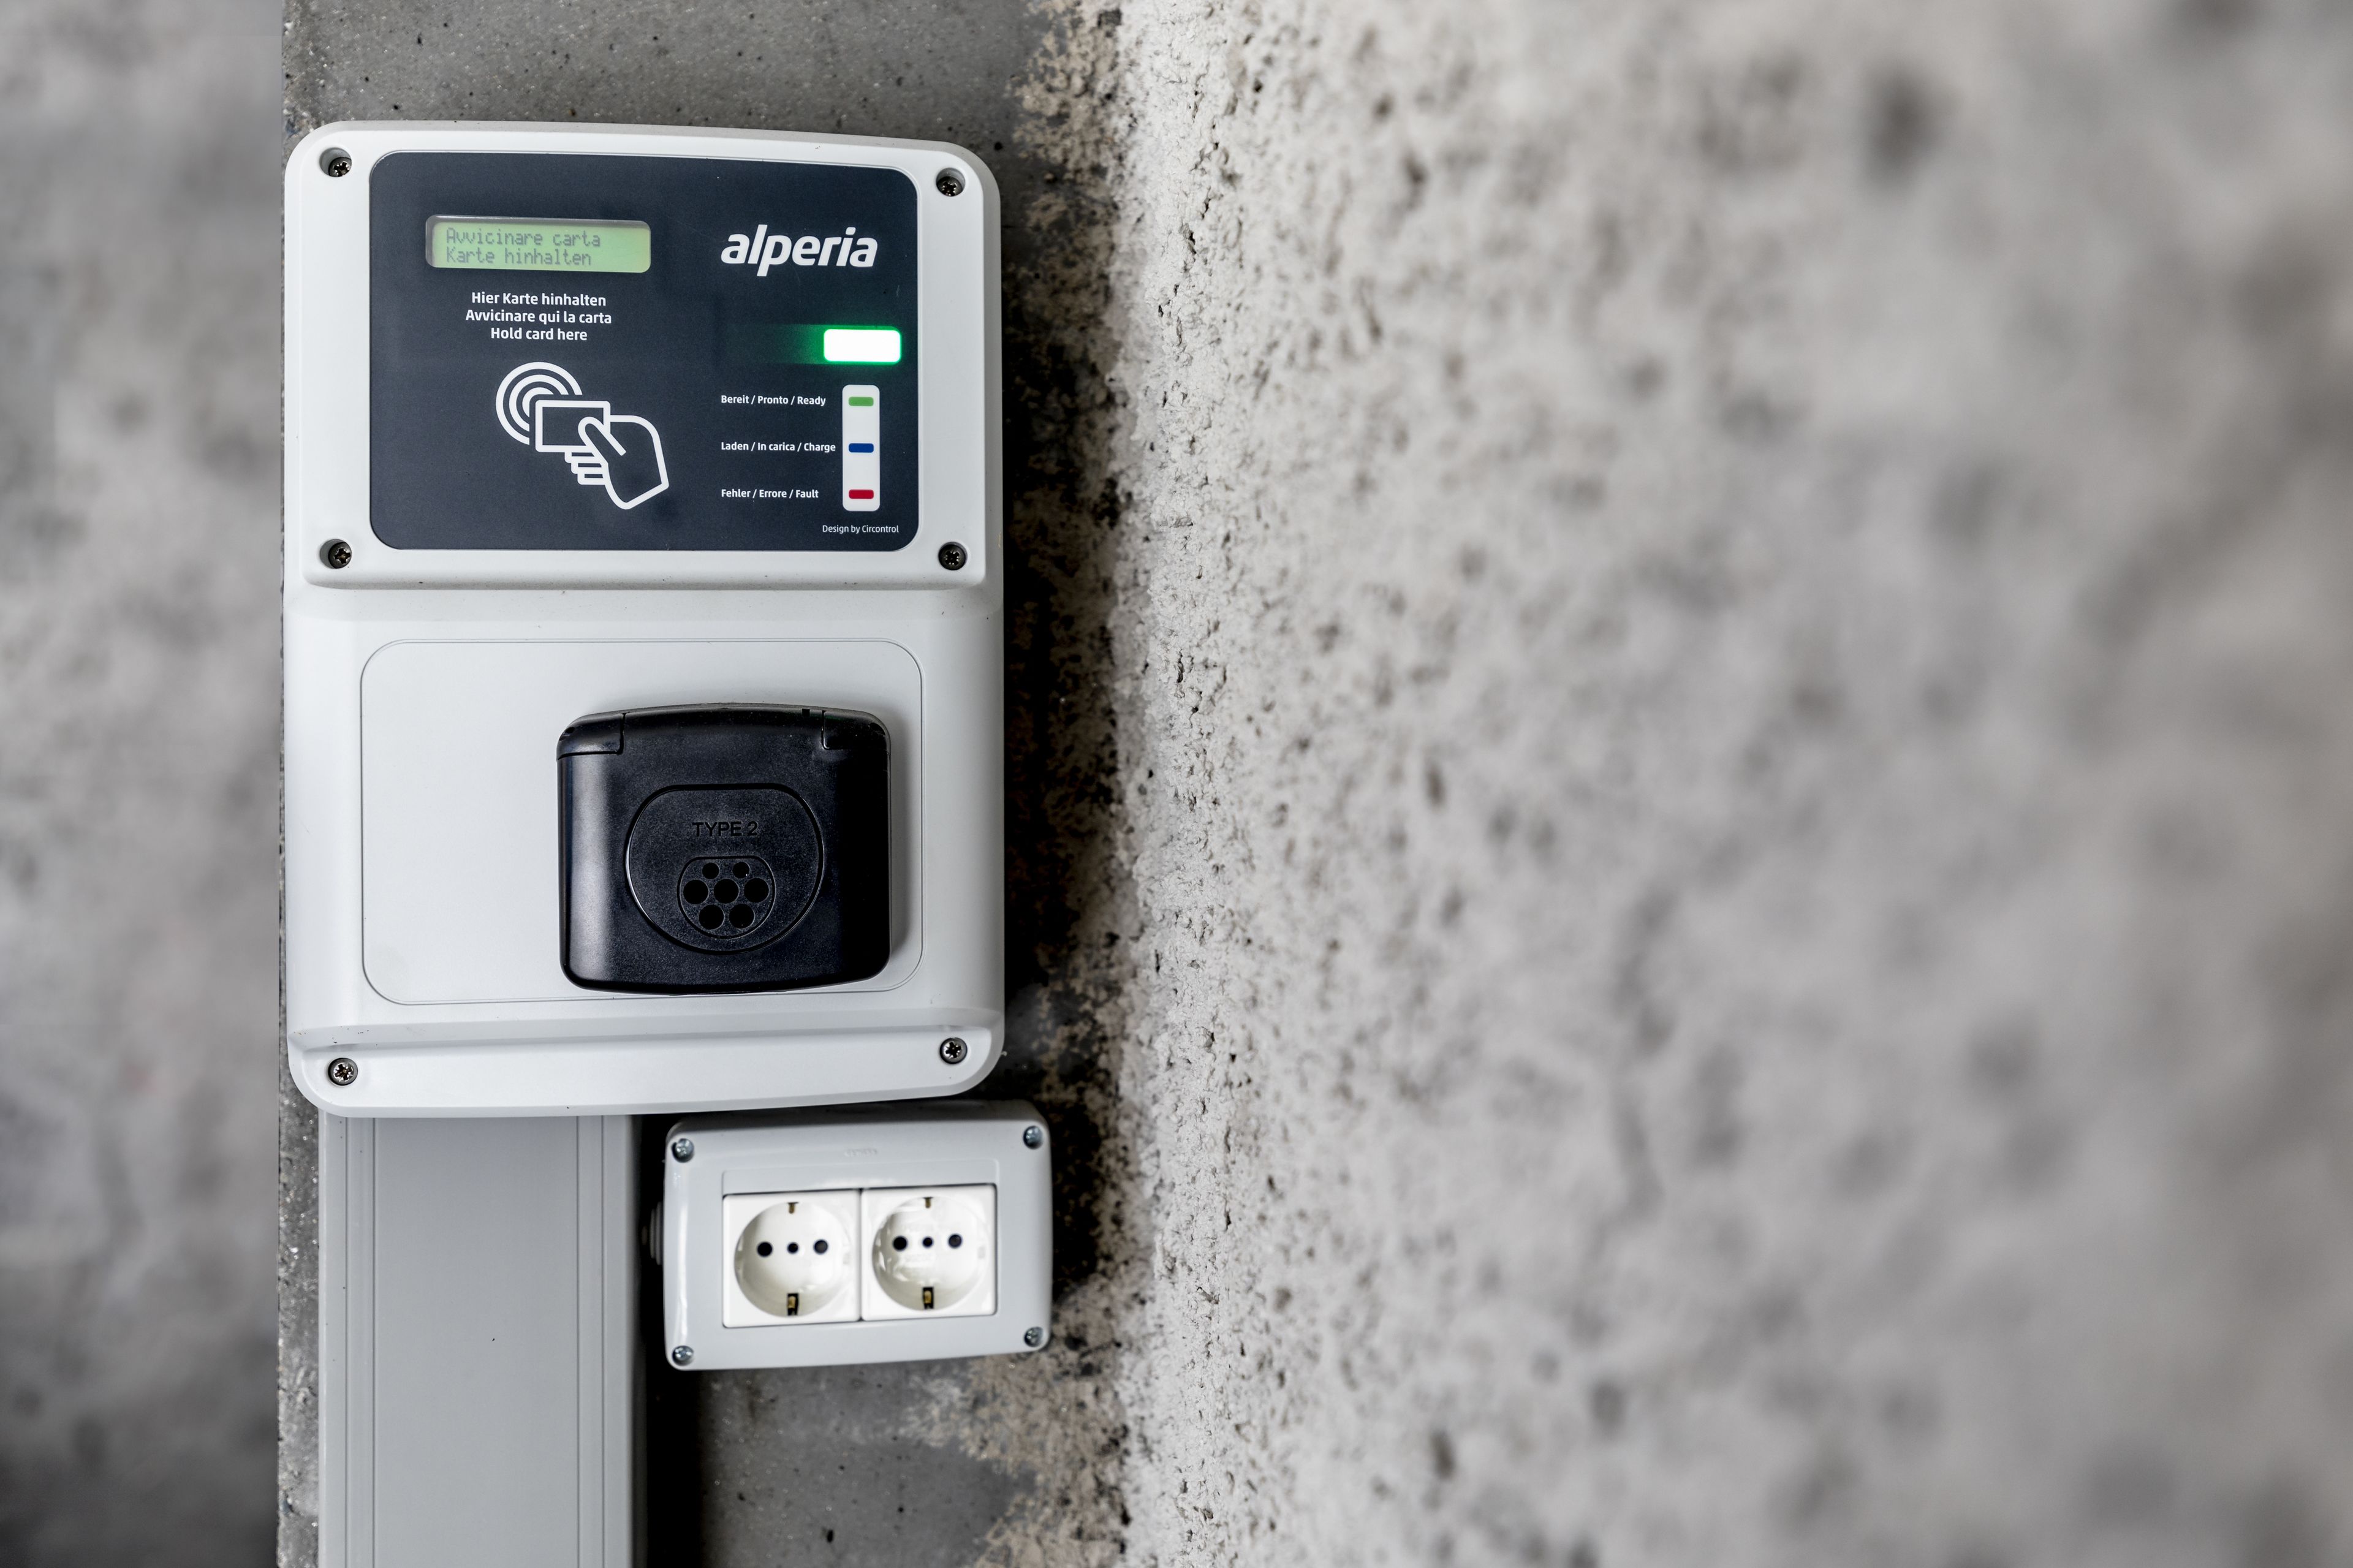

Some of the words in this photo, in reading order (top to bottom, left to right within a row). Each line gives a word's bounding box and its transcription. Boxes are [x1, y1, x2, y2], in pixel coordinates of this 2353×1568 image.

[446, 227, 543, 245] Avvicinare
[552, 230, 601, 247] carta
[446, 246, 494, 263] Karte
[504, 248, 591, 265] hinhalten
[721, 224, 877, 276] alperia
[472, 292, 500, 303] Hier
[503, 293, 538, 305] Karte
[542, 293, 606, 306] hinhalten
[466, 309, 535, 322] Avvicinare
[539, 311, 559, 325] qui
[564, 311, 575, 323] la
[579, 312, 612, 324] carta
[491, 327, 522, 339] Hold
[526, 328, 553, 339] card
[558, 328, 587, 341] here
[721, 395, 749, 403] Bereit
[751, 395, 756, 404] /
[790, 396, 795, 405] /
[797, 396, 825, 406] Ready
[721, 442, 749, 450] Laden
[751, 442, 756, 451] /
[797, 442, 801, 452] /
[804, 442, 836, 453] Charge
[752, 489, 757, 498] /
[789, 490, 794, 498] /
[823, 525, 849, 534] Design
[851, 525, 860, 534] by
[692, 821, 741, 836] TYPE
[747, 820, 758, 835] 2
